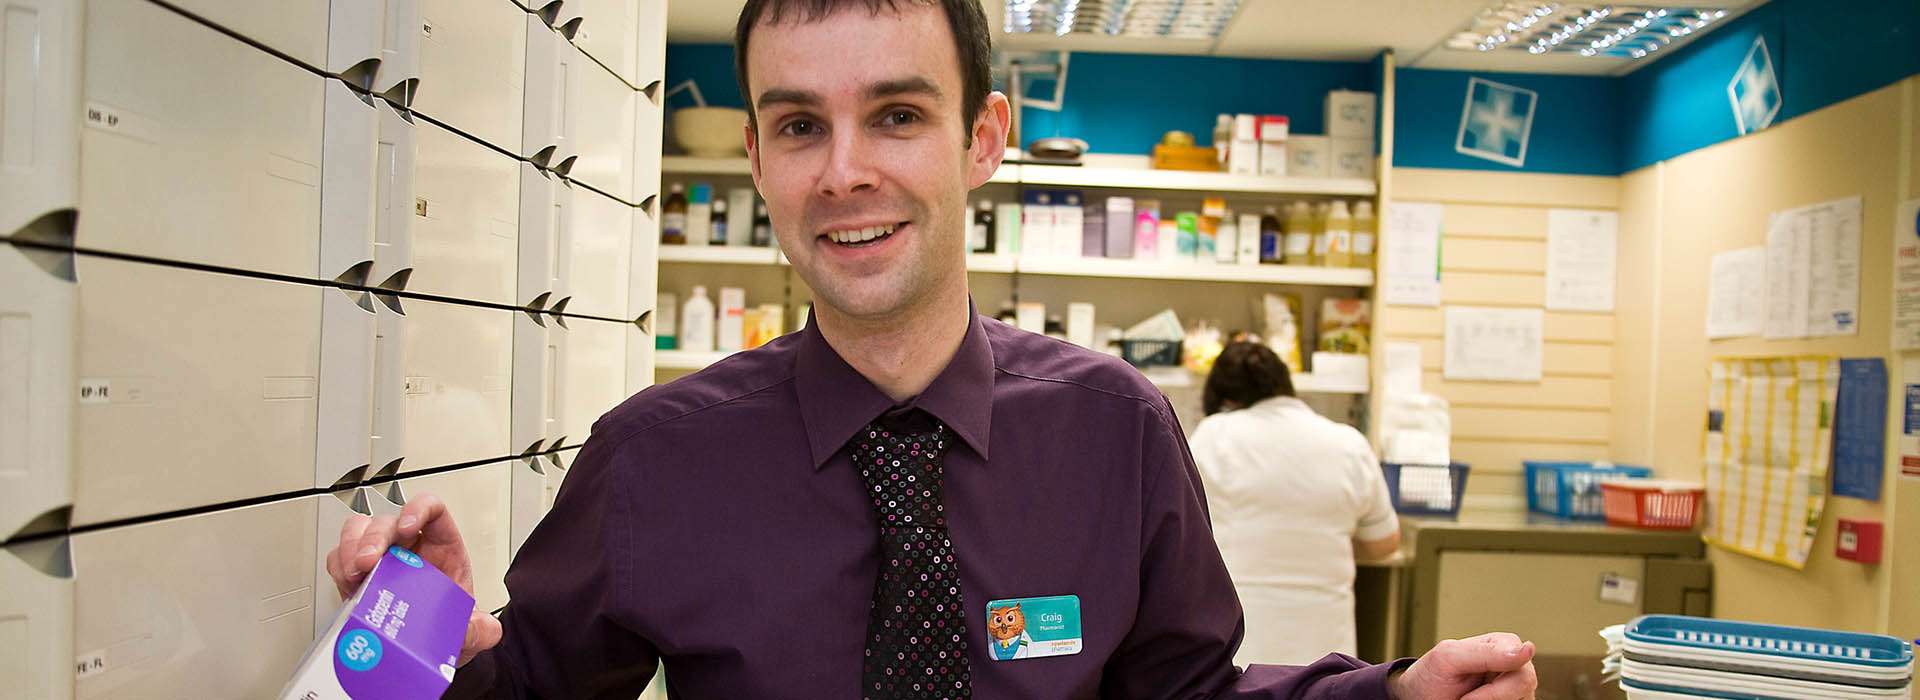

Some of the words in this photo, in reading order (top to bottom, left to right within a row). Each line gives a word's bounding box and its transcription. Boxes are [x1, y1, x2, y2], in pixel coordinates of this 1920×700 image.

[81, 386, 93, 398] EP
[1041, 612, 1063, 624] Craig
[345, 635, 369, 660] 600
[360, 647, 376, 663] mg
